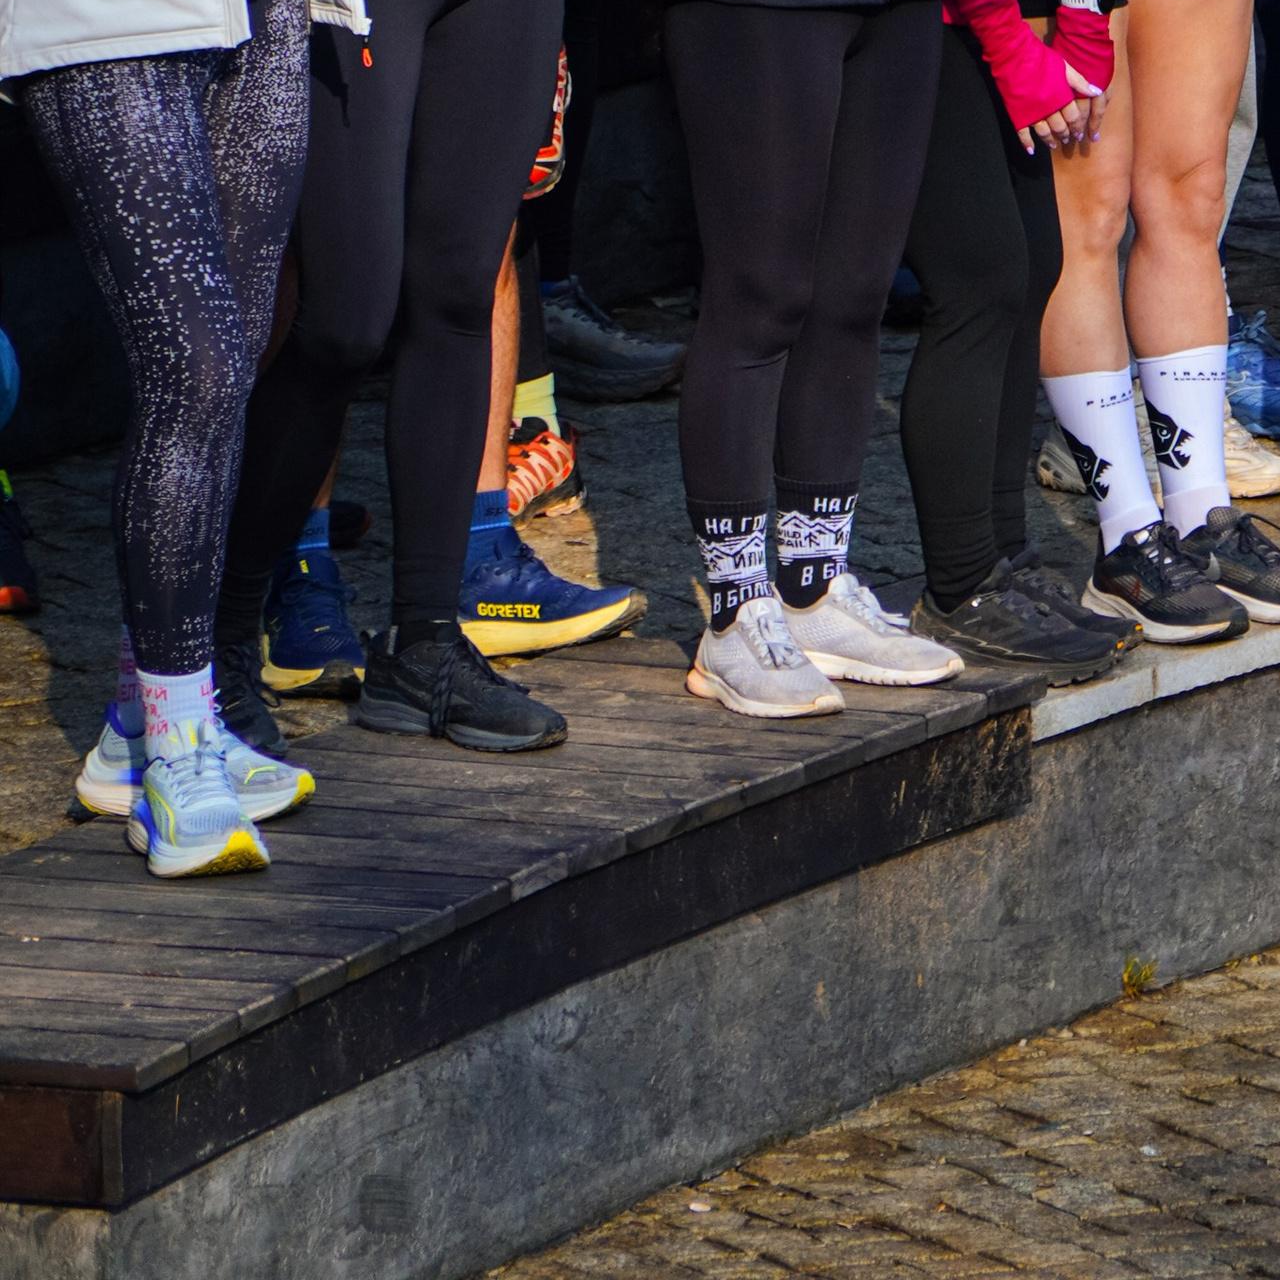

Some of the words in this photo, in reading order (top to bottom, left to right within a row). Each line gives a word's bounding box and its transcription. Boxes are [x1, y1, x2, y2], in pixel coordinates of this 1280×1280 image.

[813, 496, 842, 513] НА
[704, 518, 734, 535] НА
[476, 602, 541, 619] GORE-TEX
